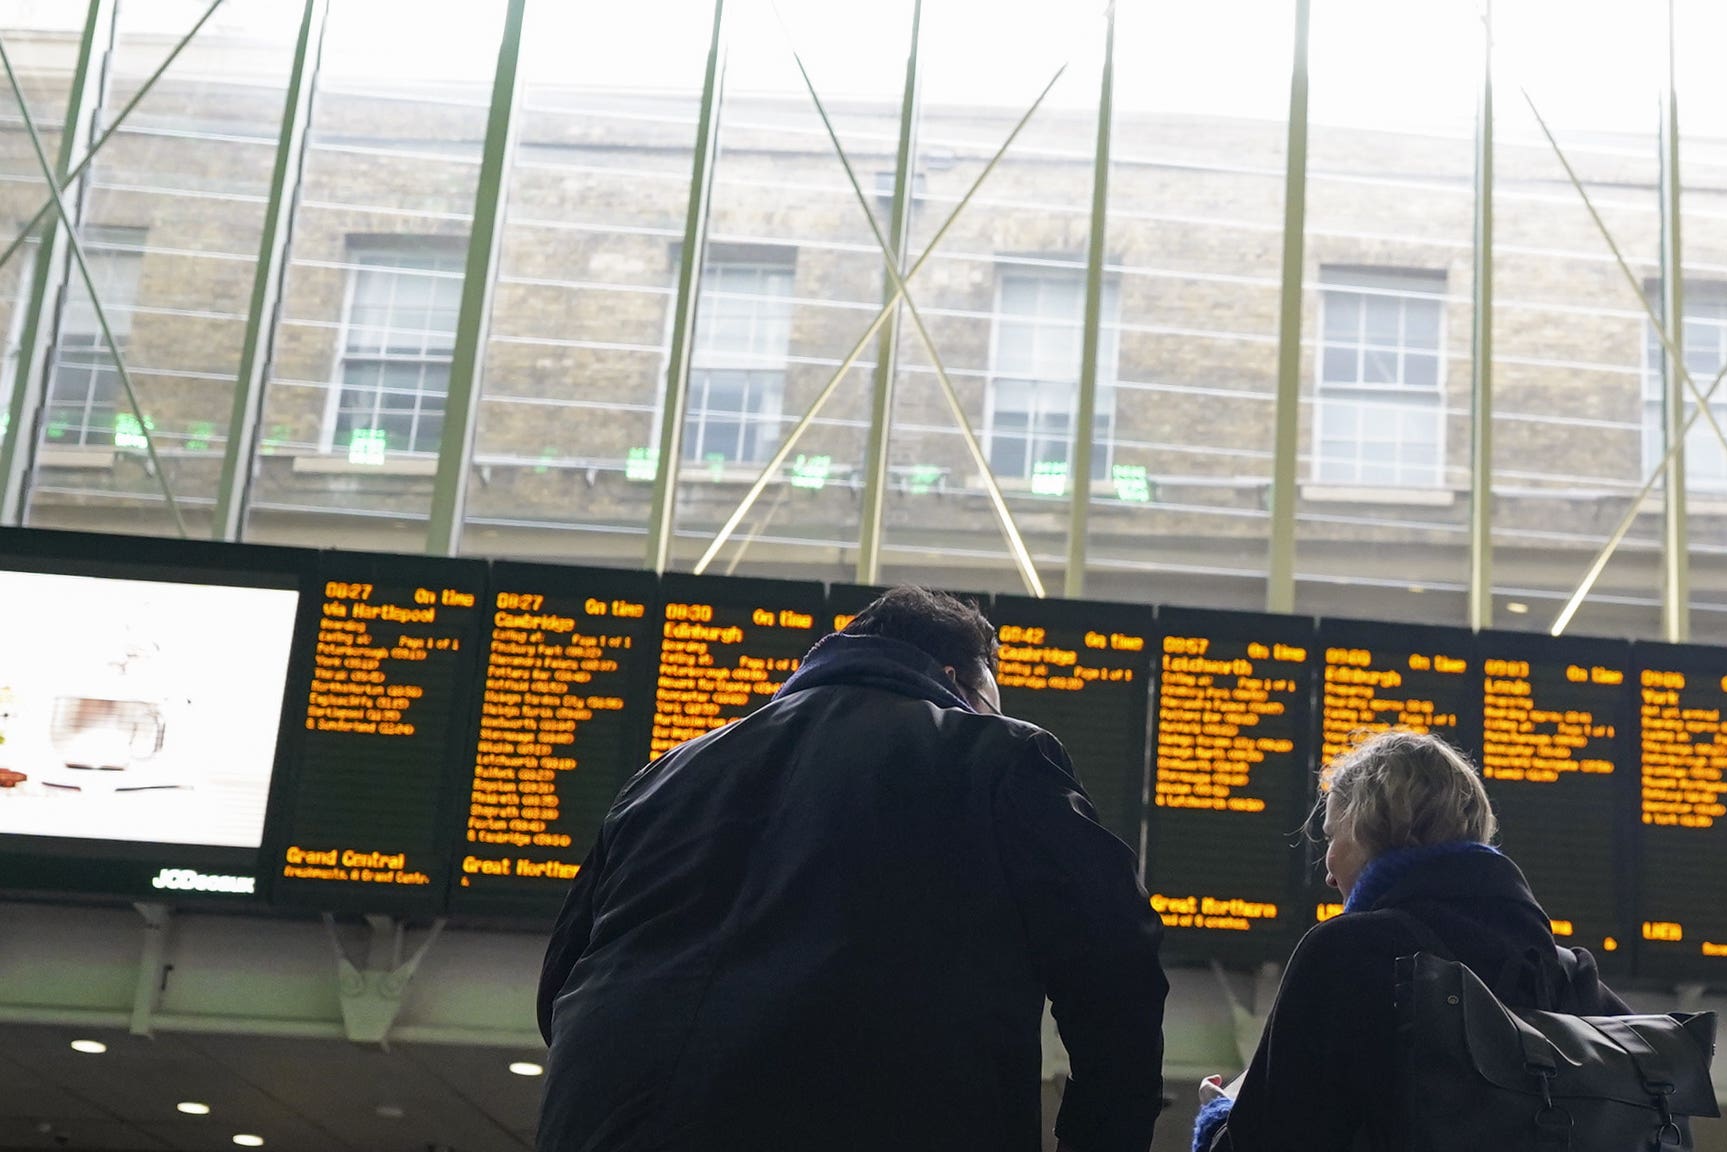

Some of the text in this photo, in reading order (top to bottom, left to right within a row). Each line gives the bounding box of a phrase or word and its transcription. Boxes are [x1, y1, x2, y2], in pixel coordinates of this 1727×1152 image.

[415, 589, 436, 603] On
[442, 590, 474, 606] time
[353, 604, 435, 622] Hartlepool
[586, 599, 606, 614] On
[612, 601, 644, 617] time
[495, 612, 575, 632] Cambridge
[753, 609, 775, 625] On
[780, 611, 812, 628] time
[664, 621, 744, 644] Edinburgh
[1085, 632, 1106, 648] On
[1111, 634, 1143, 650] time
[998, 644, 1077, 667] Cambridge
[1248, 643, 1269, 658] On
[1274, 644, 1306, 661] time
[1163, 654, 1253, 676] Letchworth
[1409, 654, 1430, 669] On
[1434, 656, 1466, 672] time
[1325, 665, 1402, 688] Edinburgh
[1567, 666, 1587, 681] On
[1592, 668, 1622, 684] time
[286, 846, 405, 870] Grand Central
[463, 856, 510, 874] Great
[1150, 894, 1277, 918] Great Northern
